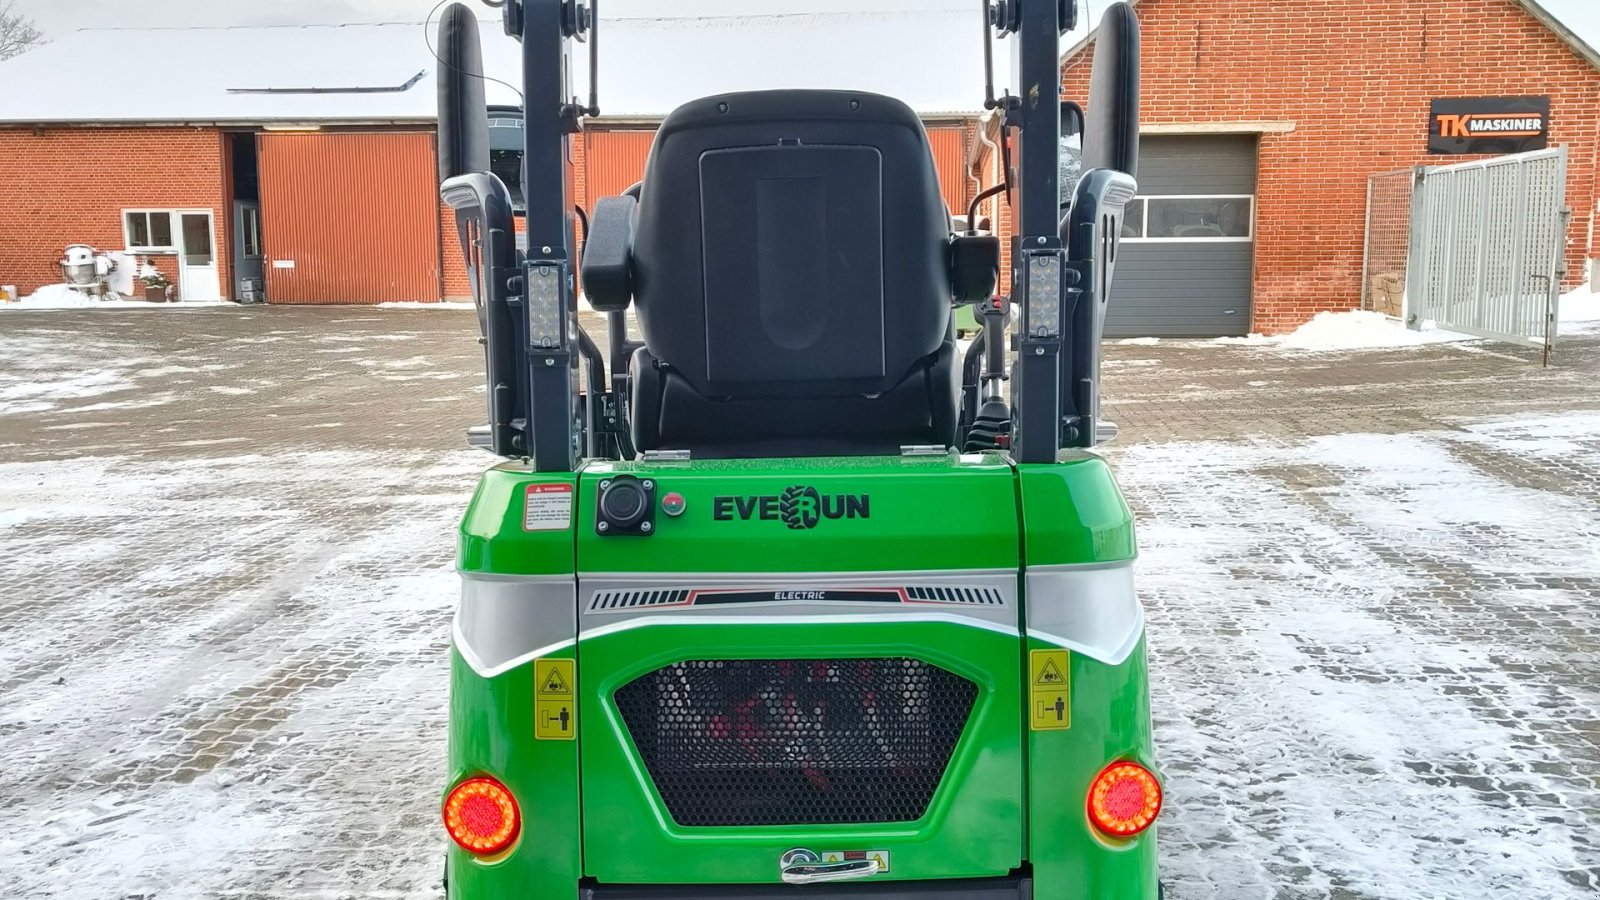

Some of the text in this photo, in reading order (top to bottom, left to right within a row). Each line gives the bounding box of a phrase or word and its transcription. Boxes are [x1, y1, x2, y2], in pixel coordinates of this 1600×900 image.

[1437, 114, 1542, 137] TK MASKINER
[713, 485, 870, 530] EVERUN
[774, 591, 825, 600] ELECTRIC
